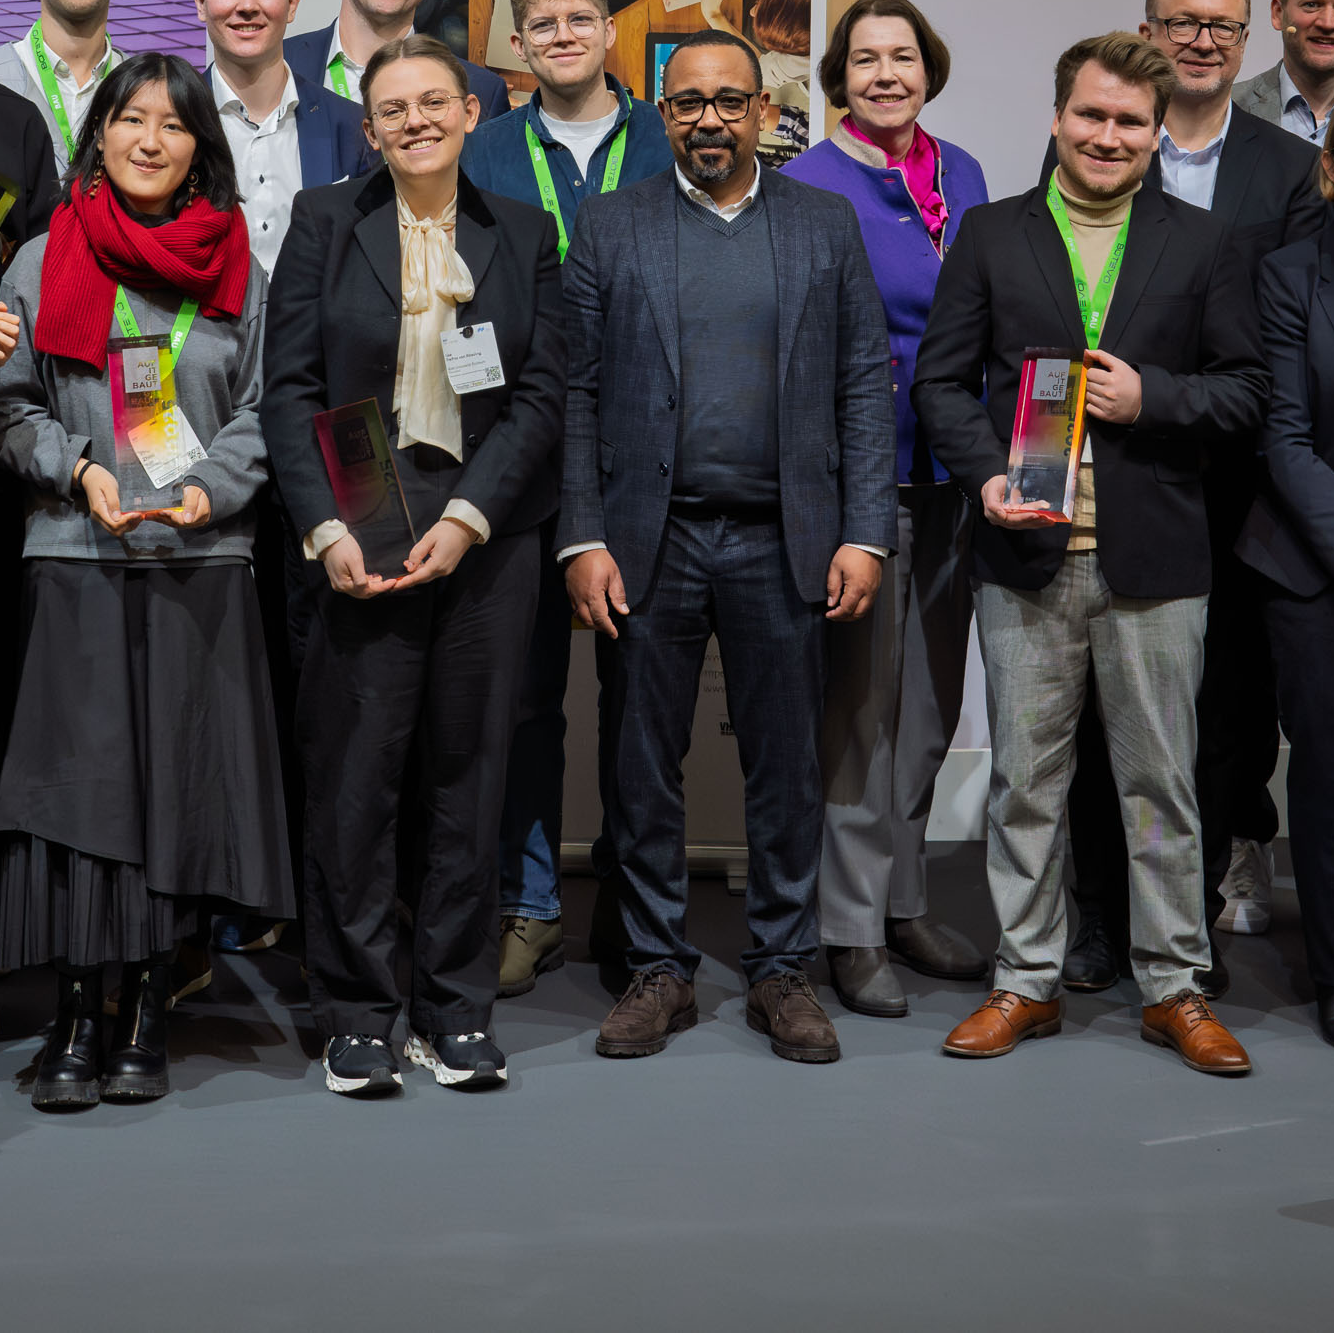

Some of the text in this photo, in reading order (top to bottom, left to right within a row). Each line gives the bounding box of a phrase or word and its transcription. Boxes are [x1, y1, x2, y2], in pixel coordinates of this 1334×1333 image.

[50, 94, 62, 110] BAU
[1102, 242, 1125, 285] BOTEVO
[1089, 311, 1100, 329] BAU
[171, 330, 184, 349] BAU
[1057, 377, 1066, 385] IT
